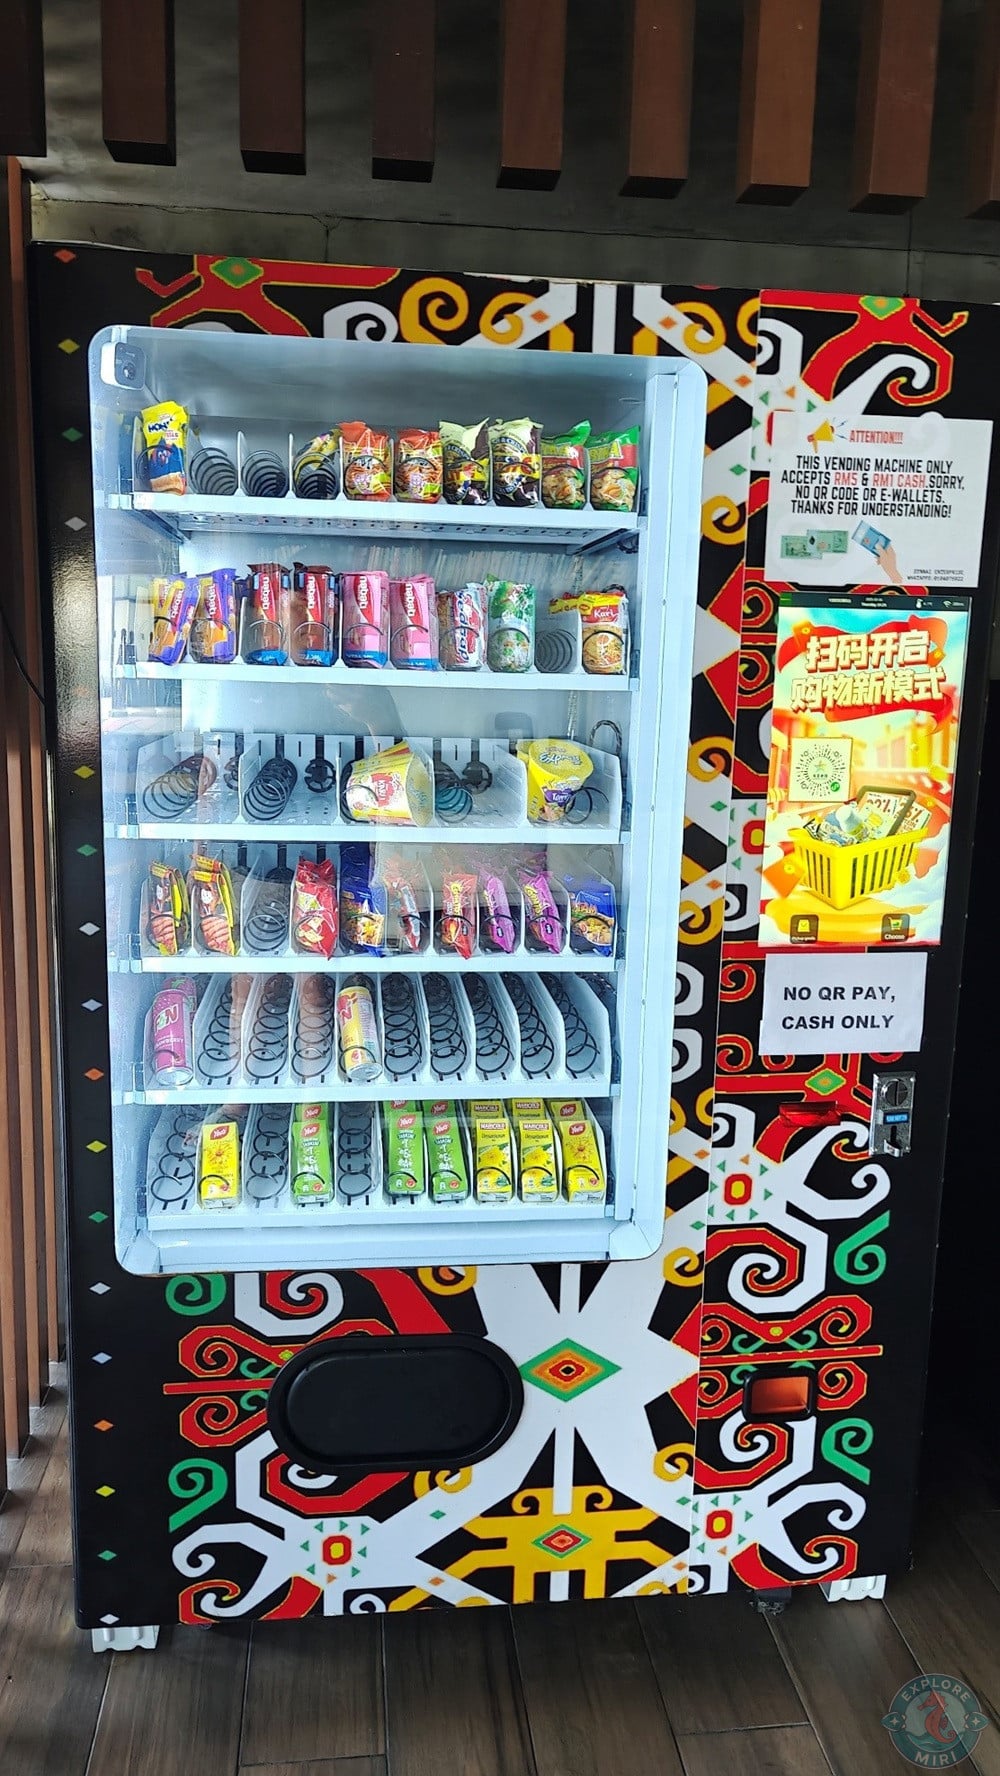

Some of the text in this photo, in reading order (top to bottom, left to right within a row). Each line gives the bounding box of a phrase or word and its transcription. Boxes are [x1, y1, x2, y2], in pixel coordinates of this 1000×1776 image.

[849, 430, 903, 444] ATTENTION!!!
[796, 455, 953, 474] THIS VENDING MACHINE ONLY
[781, 470, 831, 485] ACCEPTS
[834, 472, 858, 486] RM5
[861, 473, 869, 486] &
[872, 474, 894, 488] RM1
[795, 486, 945, 503] NO QR CODE OR E-WALLETS.
[791, 500, 952, 518] THANKS FOR UNDERSTANDING!
[805, 630, 930, 672] 扫码开启
[790, 667, 946, 713] 购物新模式
[783, 986, 896, 1003] NO QR PAY,
[781, 1015, 894, 1030] CASH ONLY
